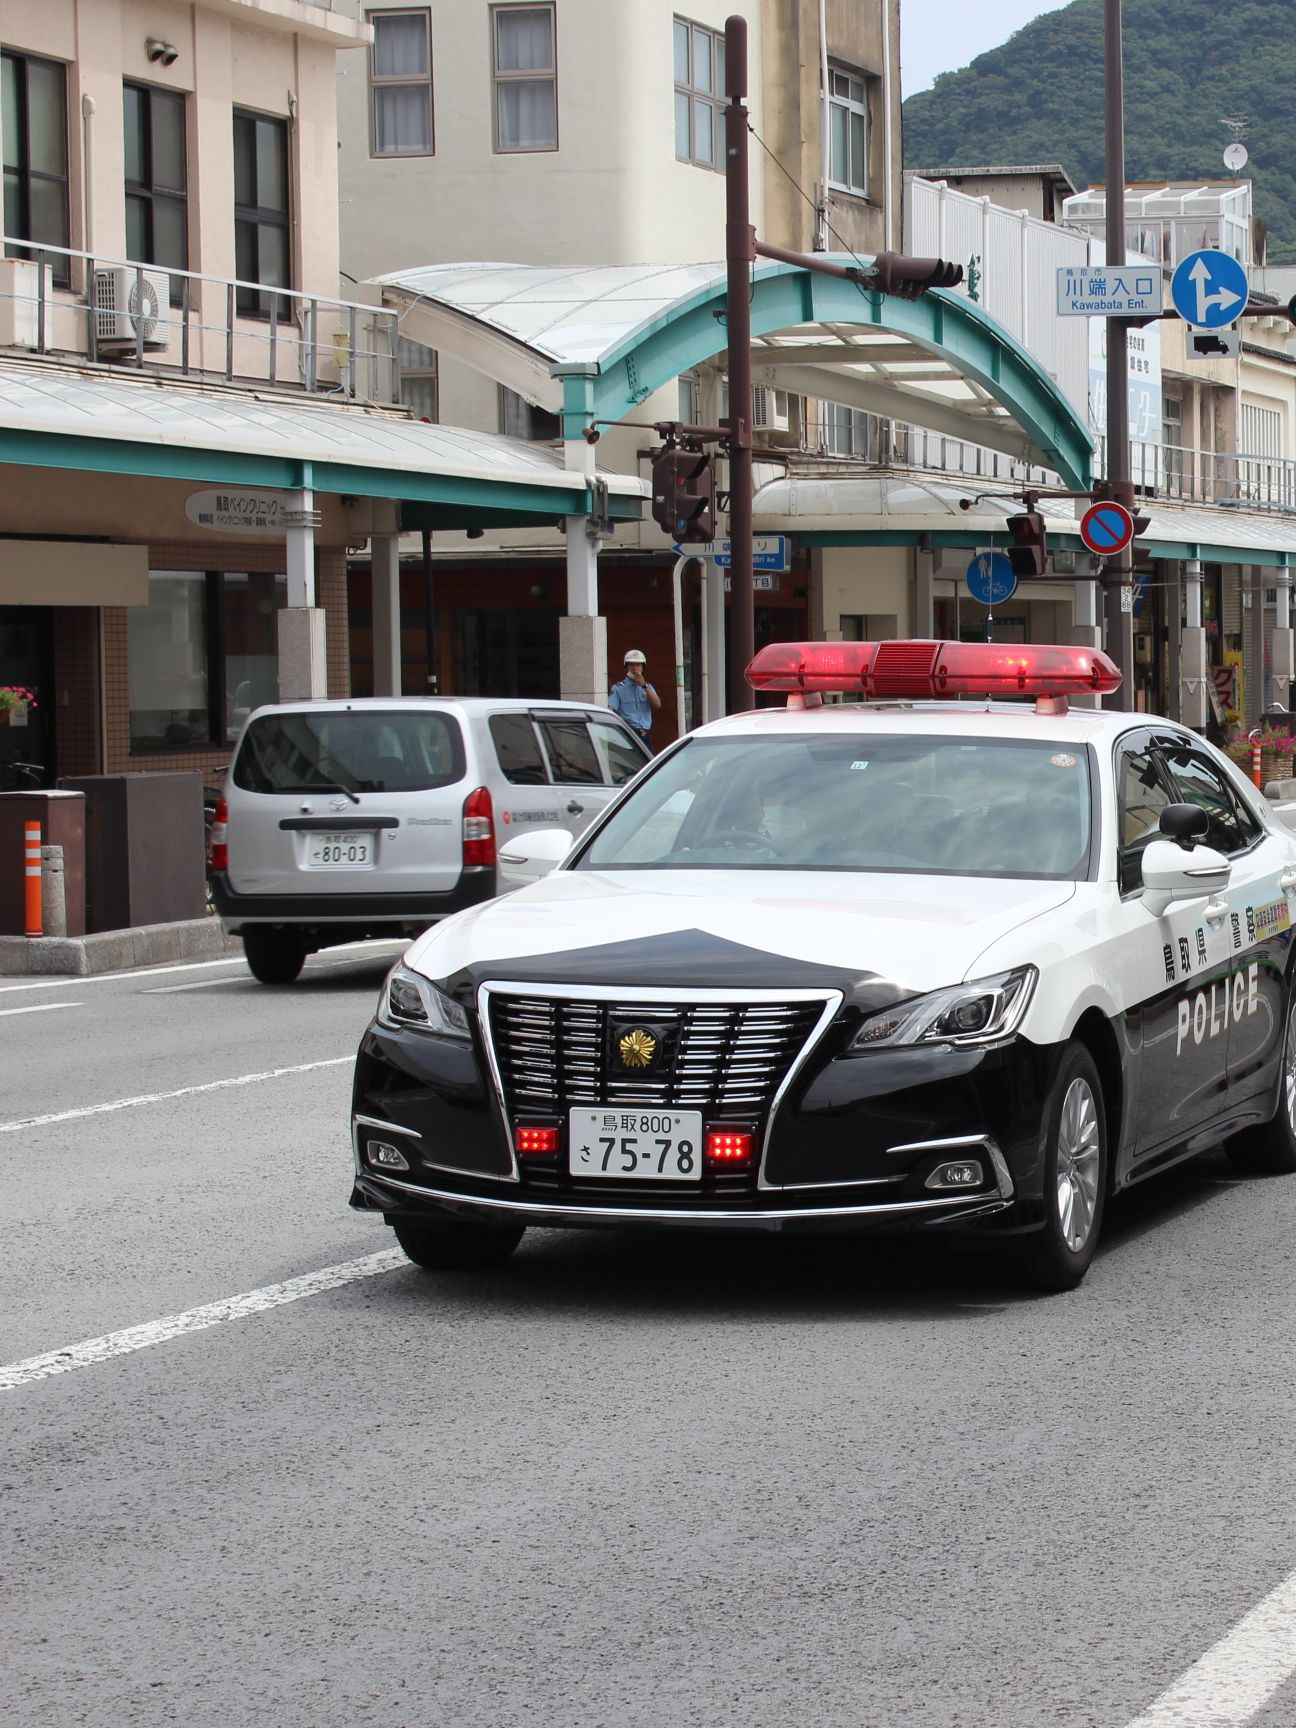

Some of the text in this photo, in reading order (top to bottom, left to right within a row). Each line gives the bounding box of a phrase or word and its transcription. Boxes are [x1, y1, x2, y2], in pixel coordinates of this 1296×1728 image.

[1066, 268, 1103, 277] 鳥取市
[1065, 278, 1153, 297] 川端入口
[1071, 298, 1148, 311] Kawabata Ent.
[1122, 587, 1131, 595] 34
[322, 846, 367, 863] 80-03
[1176, 962, 1258, 1058] POLICE
[601, 1114, 672, 1134] 鳥取800
[579, 1137, 694, 1174] さ 75-78
